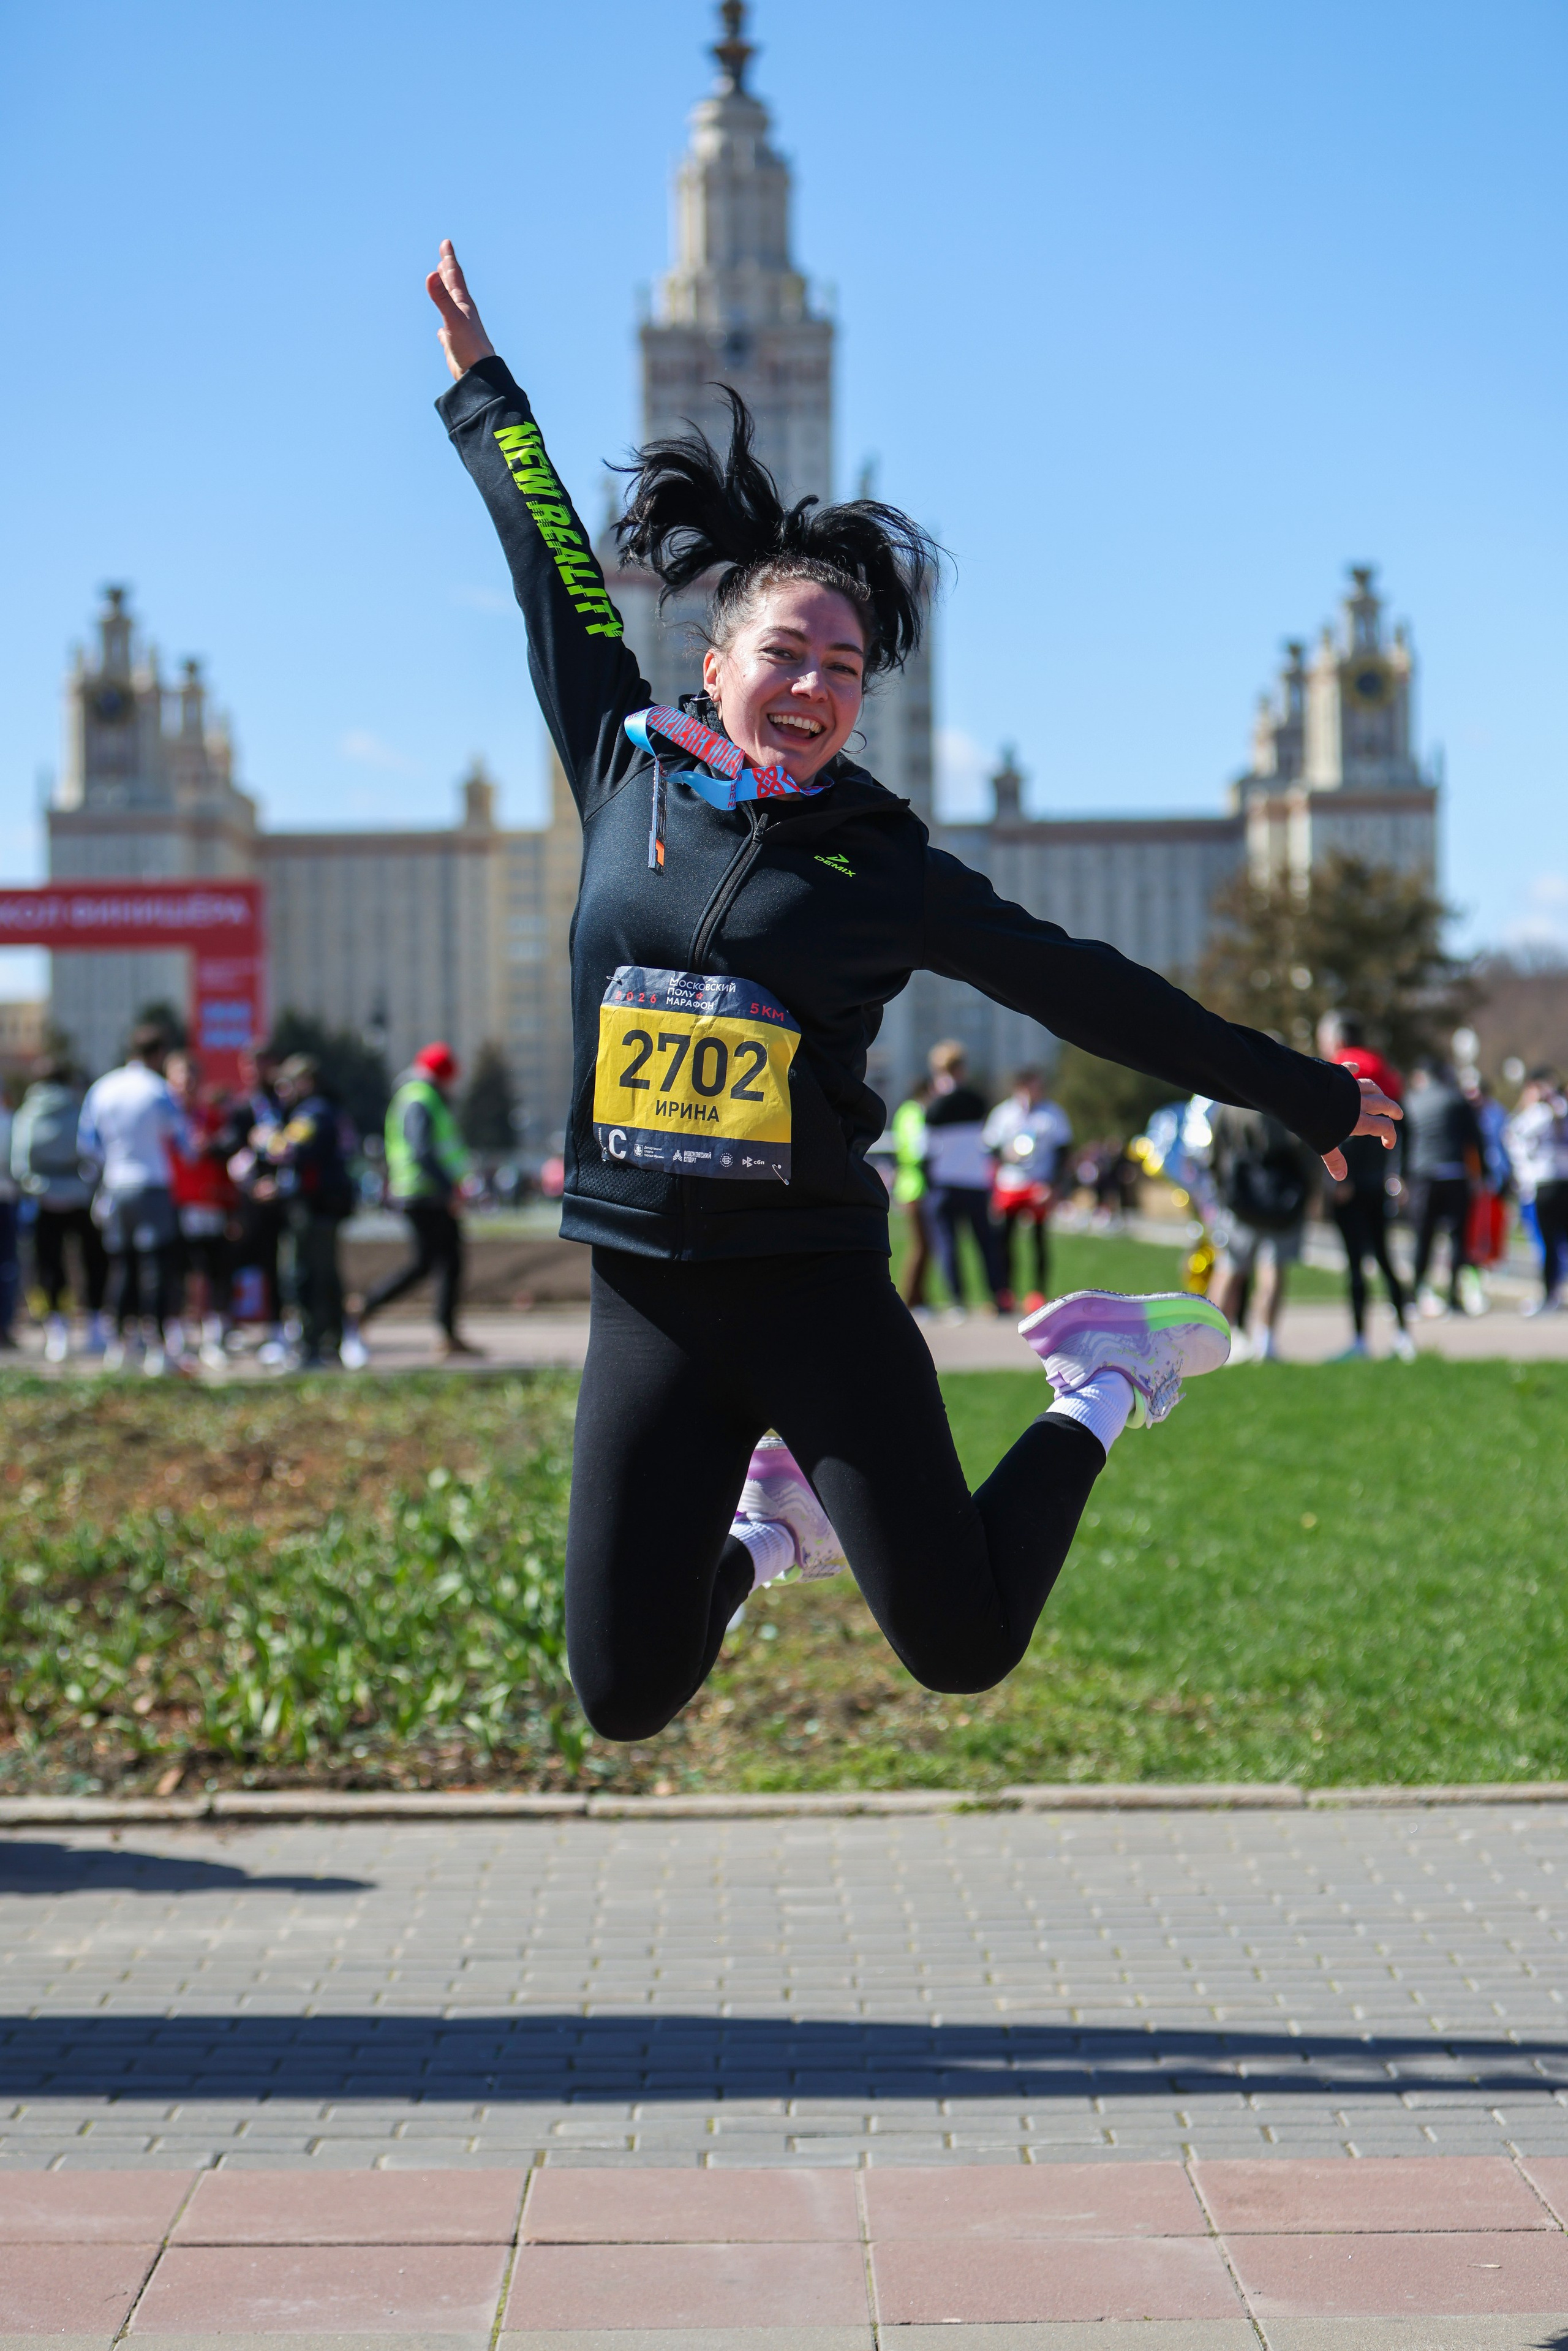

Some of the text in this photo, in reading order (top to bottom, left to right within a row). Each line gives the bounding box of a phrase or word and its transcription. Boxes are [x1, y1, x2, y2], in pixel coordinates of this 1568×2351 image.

[493, 421, 624, 638] NEW REALITY
[814, 855, 856, 878] DEMIX
[669, 977, 736, 993] МОСКОВСКИЙ
[615, 991, 657, 1003] 2026
[668, 987, 695, 998] ПОЛУ
[666, 997, 714, 1009] МАРАФОН
[750, 1003, 760, 1014] 5
[619, 1030, 767, 1101] 2702
[655, 1100, 720, 1122] ИРИНА
[684, 1150, 712, 1159] МОСКОВСКИЙ
